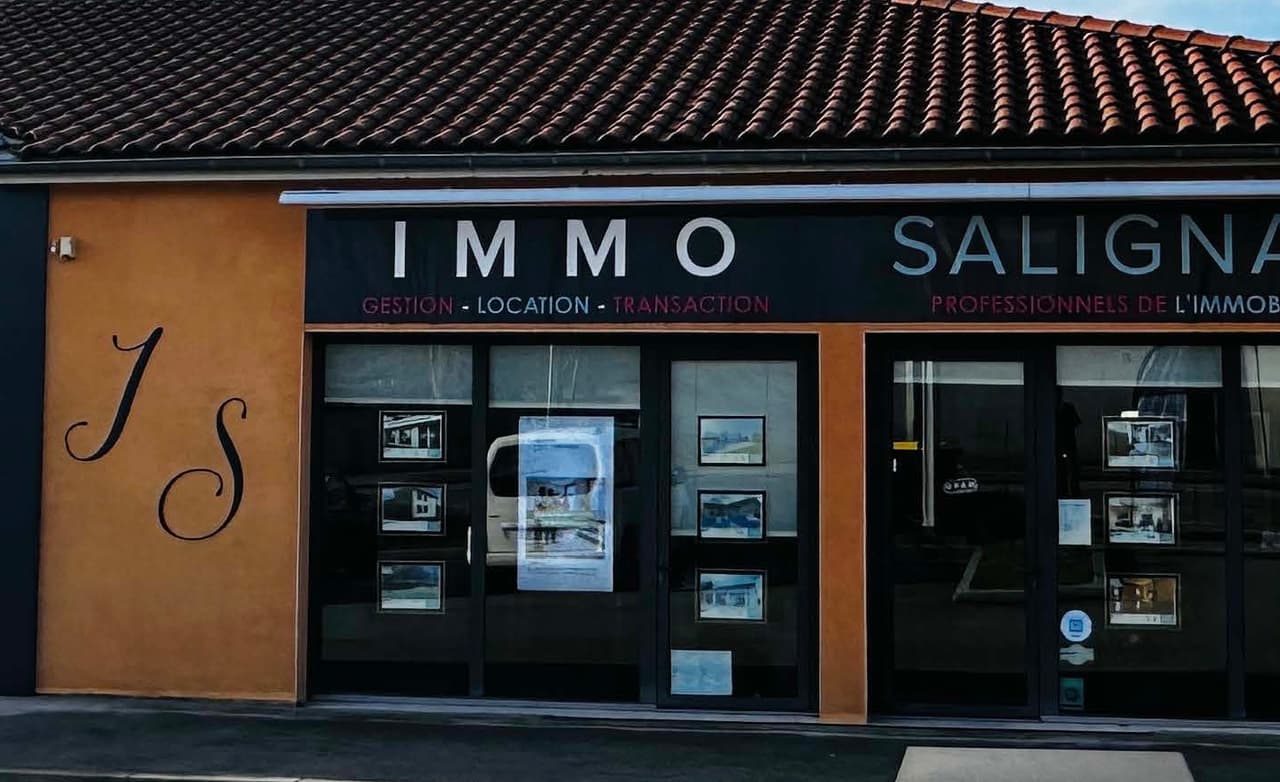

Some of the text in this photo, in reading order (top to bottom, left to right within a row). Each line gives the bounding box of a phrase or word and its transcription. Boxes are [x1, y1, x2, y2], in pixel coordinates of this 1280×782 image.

[394, 216, 736, 278] IMMO
[362, 296, 454, 315] GESTION
[477, 296, 590, 315] LOCATION
[613, 295, 770, 314] TRANSACTION
[931, 294, 1129, 314] PROFESSIONNELS
[1138, 295, 1168, 314] DE
